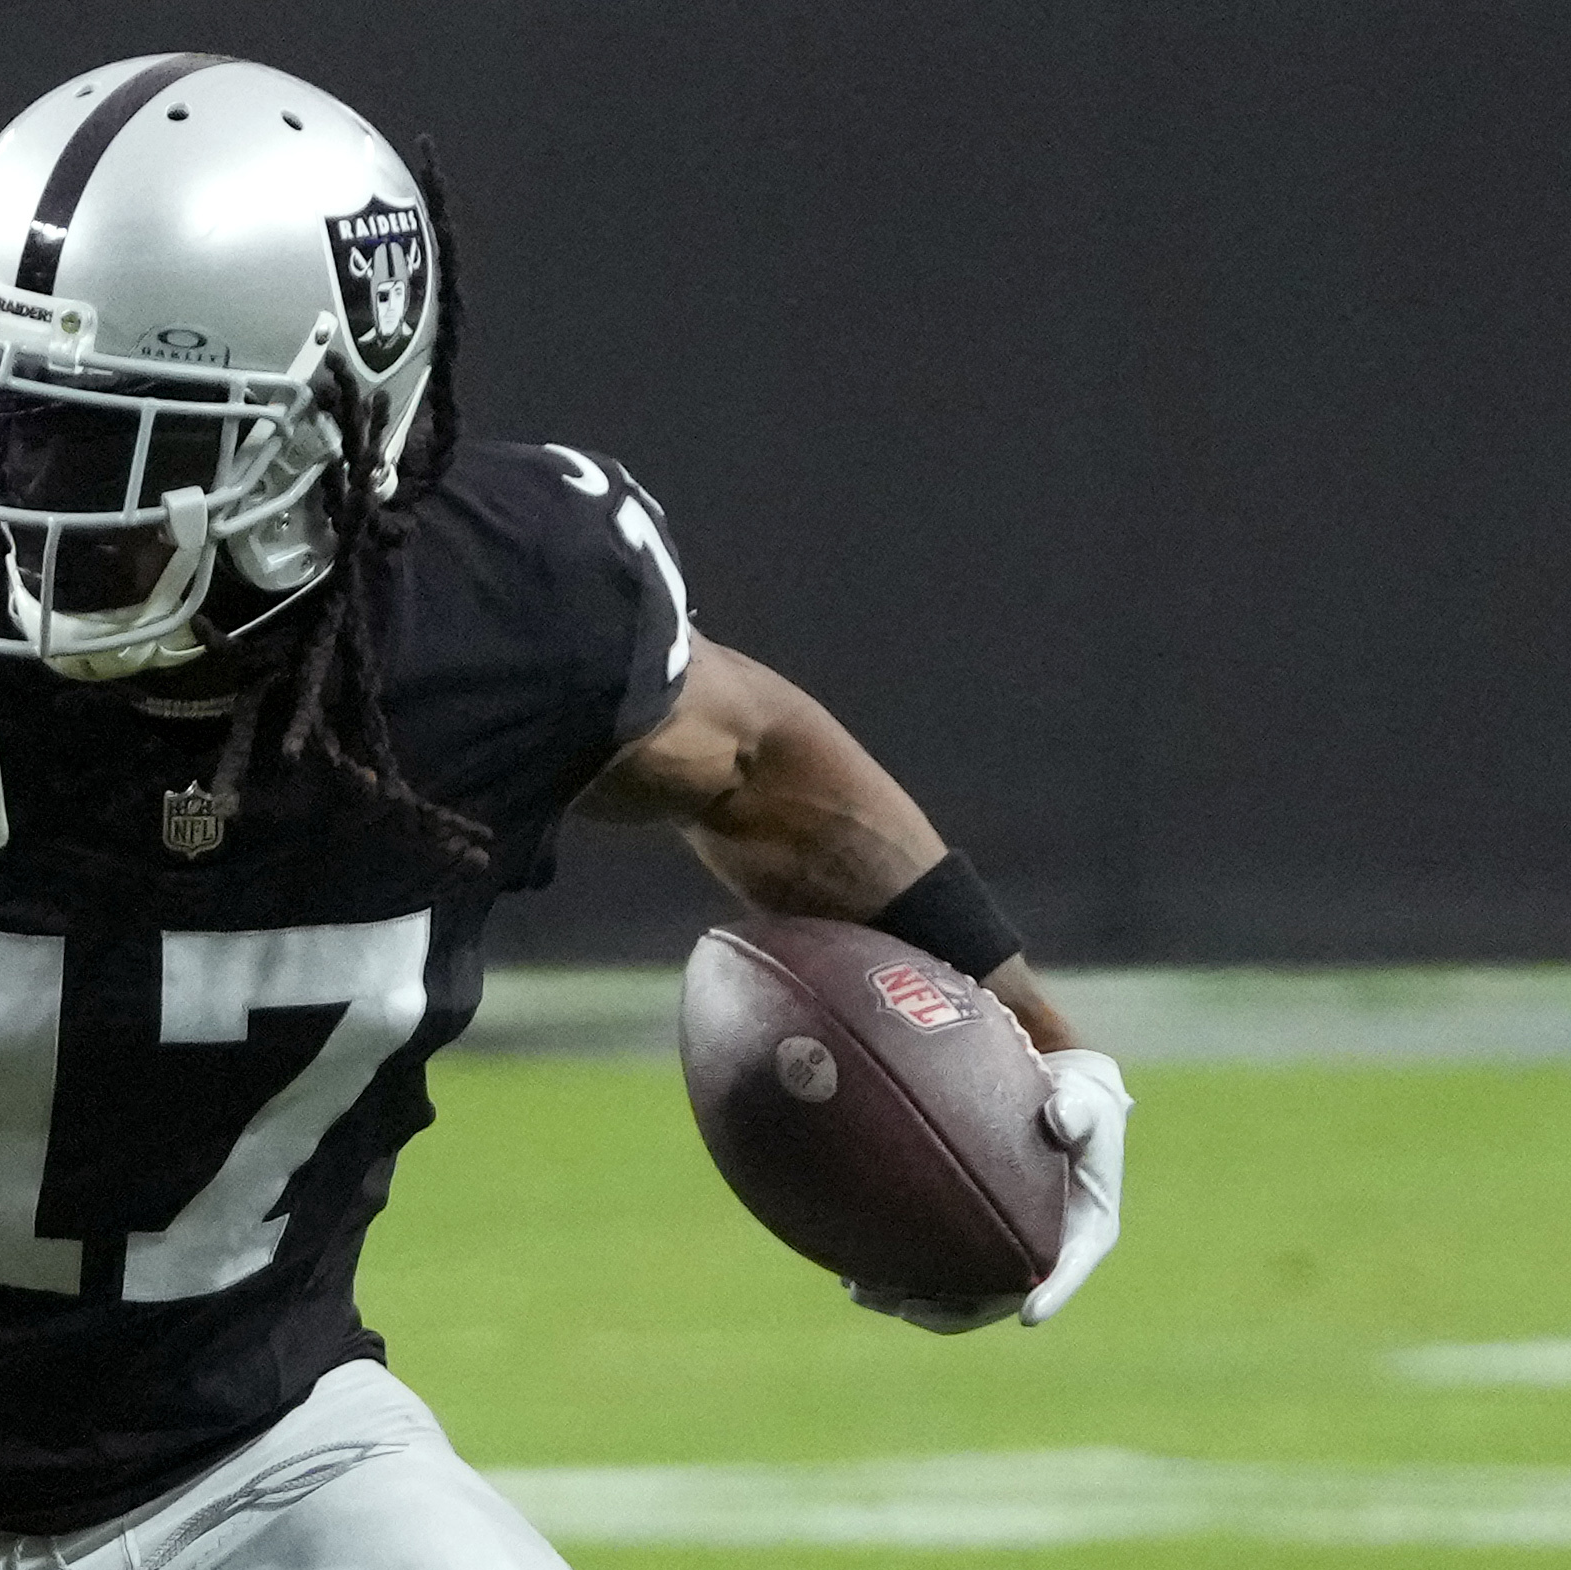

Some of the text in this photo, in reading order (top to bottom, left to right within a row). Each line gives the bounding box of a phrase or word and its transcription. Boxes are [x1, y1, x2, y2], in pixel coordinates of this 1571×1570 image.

[338, 209, 418, 240] RAIDERS
[170, 817, 215, 844] NFL
[879, 966, 947, 1024] NFL
